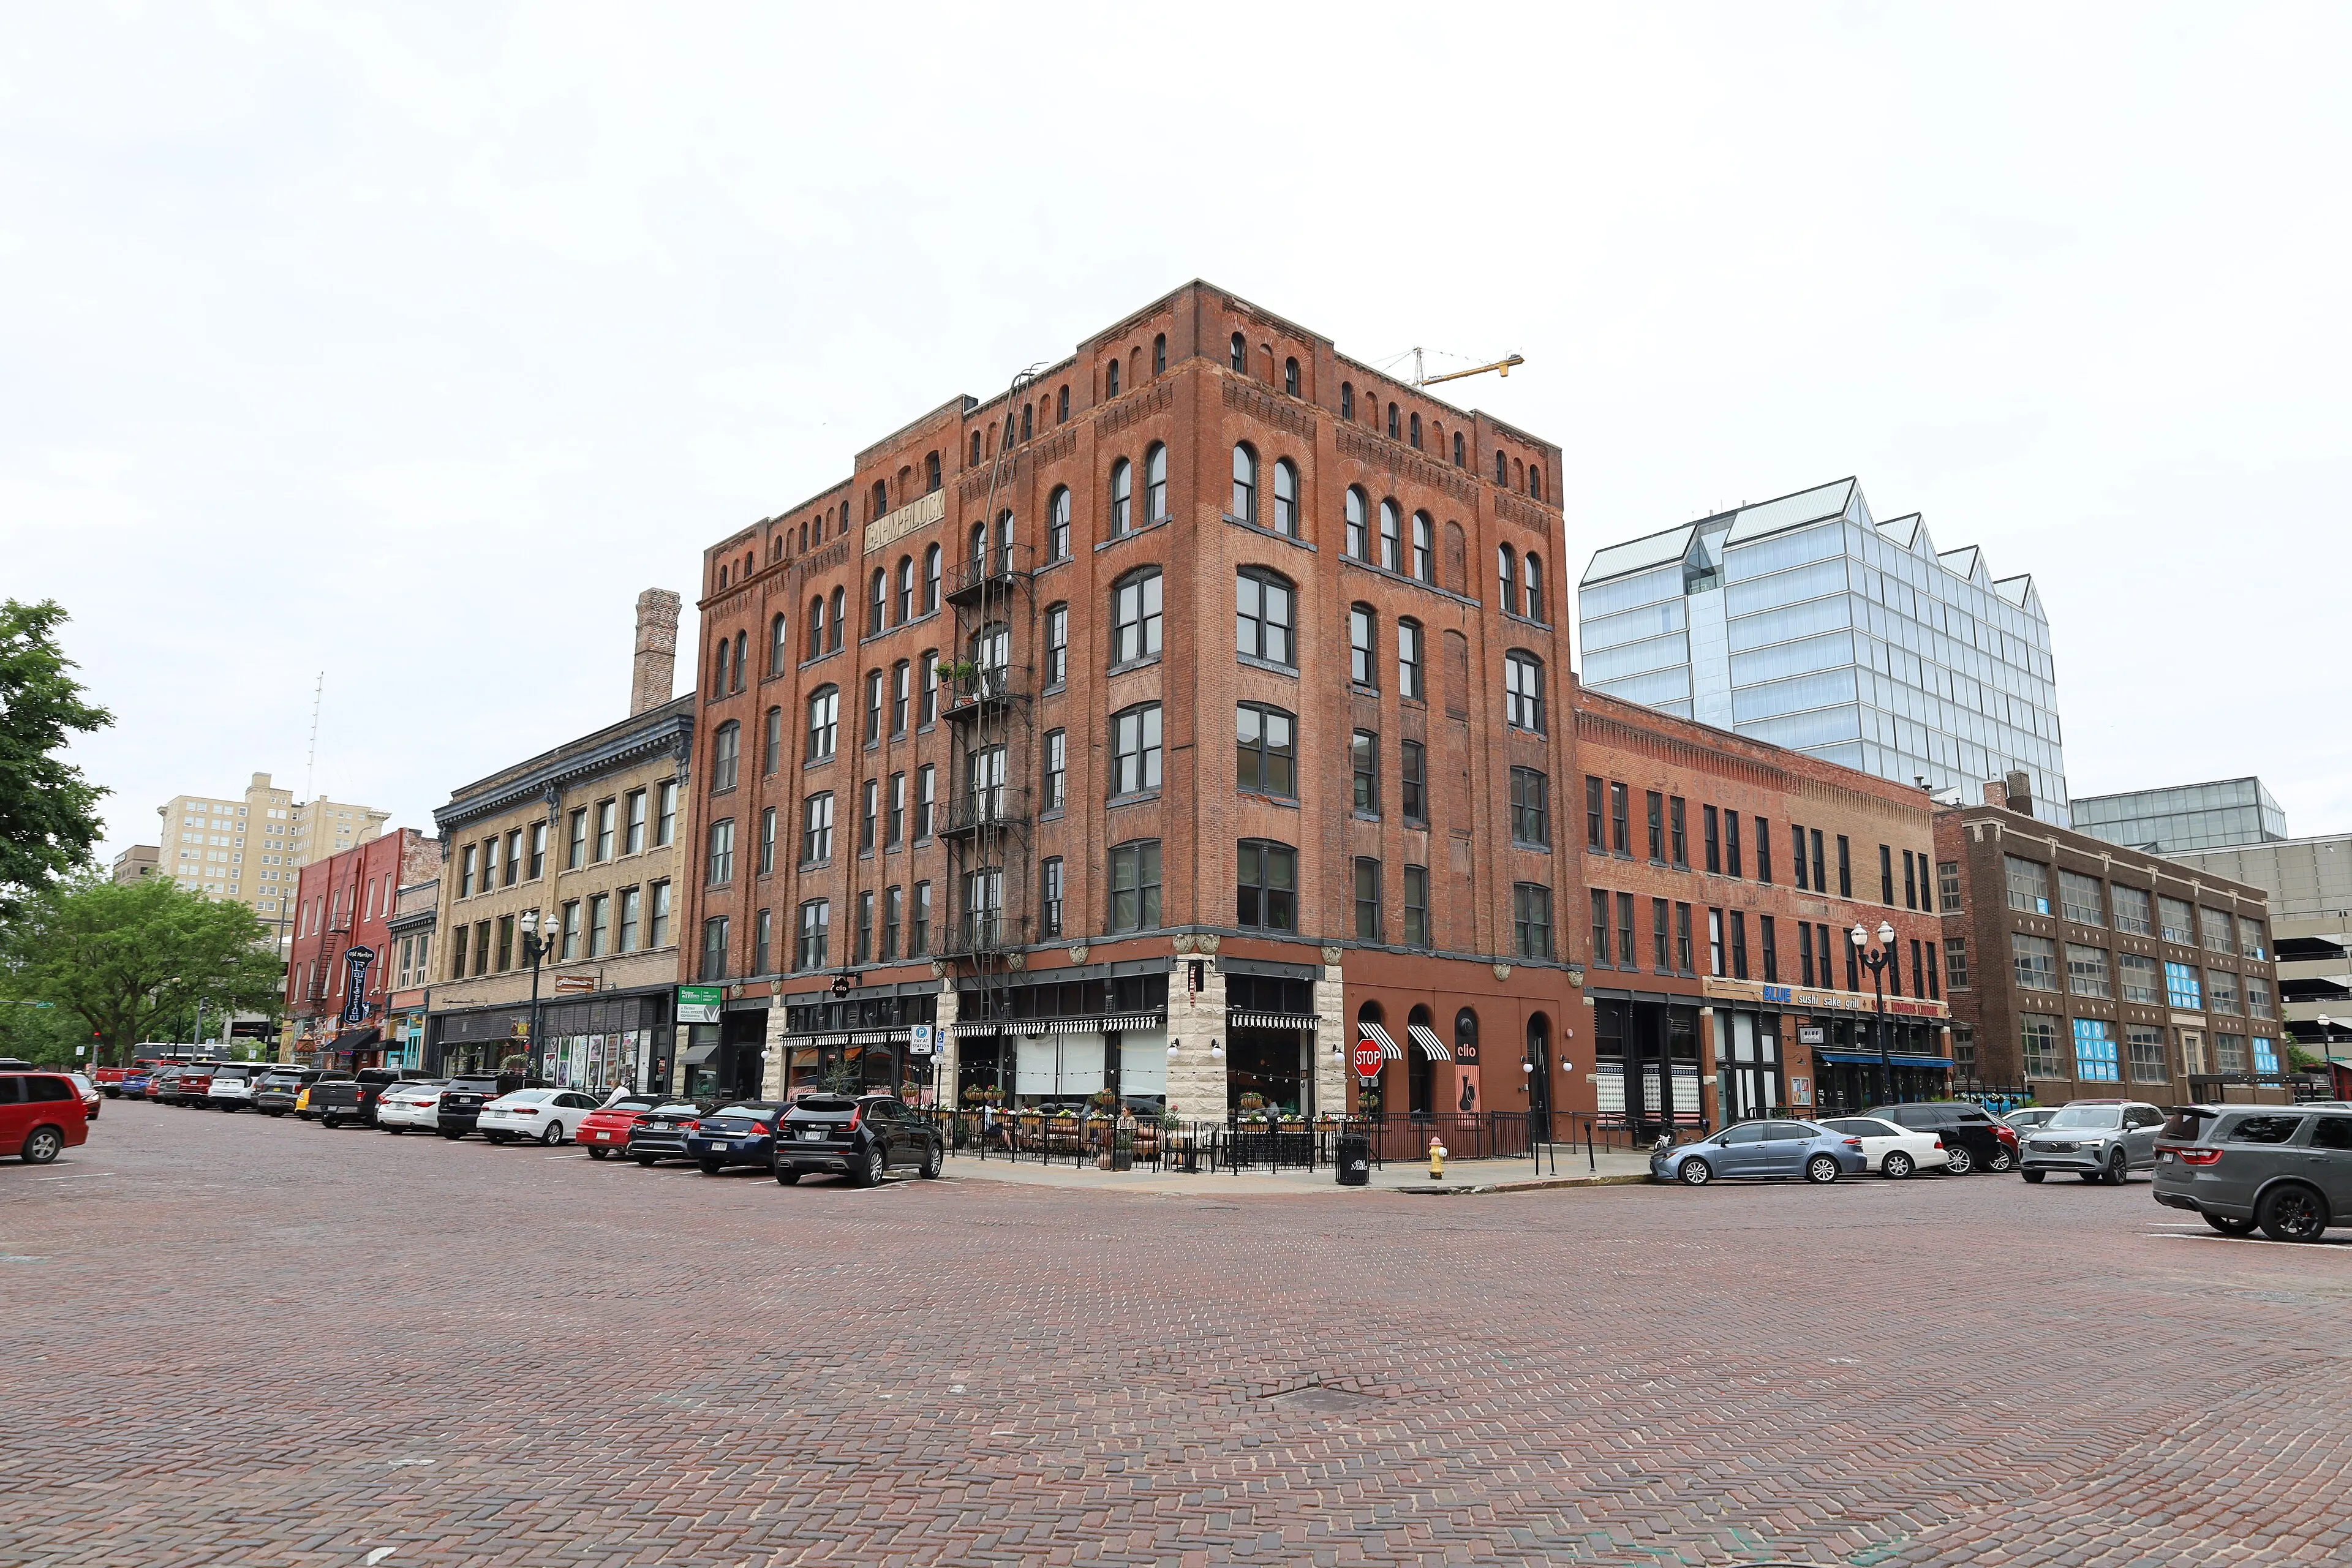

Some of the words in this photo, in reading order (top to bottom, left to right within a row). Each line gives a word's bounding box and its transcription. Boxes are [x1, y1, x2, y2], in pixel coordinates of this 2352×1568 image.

[1763, 985, 1791, 1002] BLUE
[1798, 994, 1819, 1005] sushi
[1823, 996, 1841, 1007] sake
[1845, 998, 1859, 1010] grill
[1871, 1000, 1888, 1012] SE
[1355, 1050, 1381, 1065] STOP
[1457, 1043, 1476, 1057] clio
